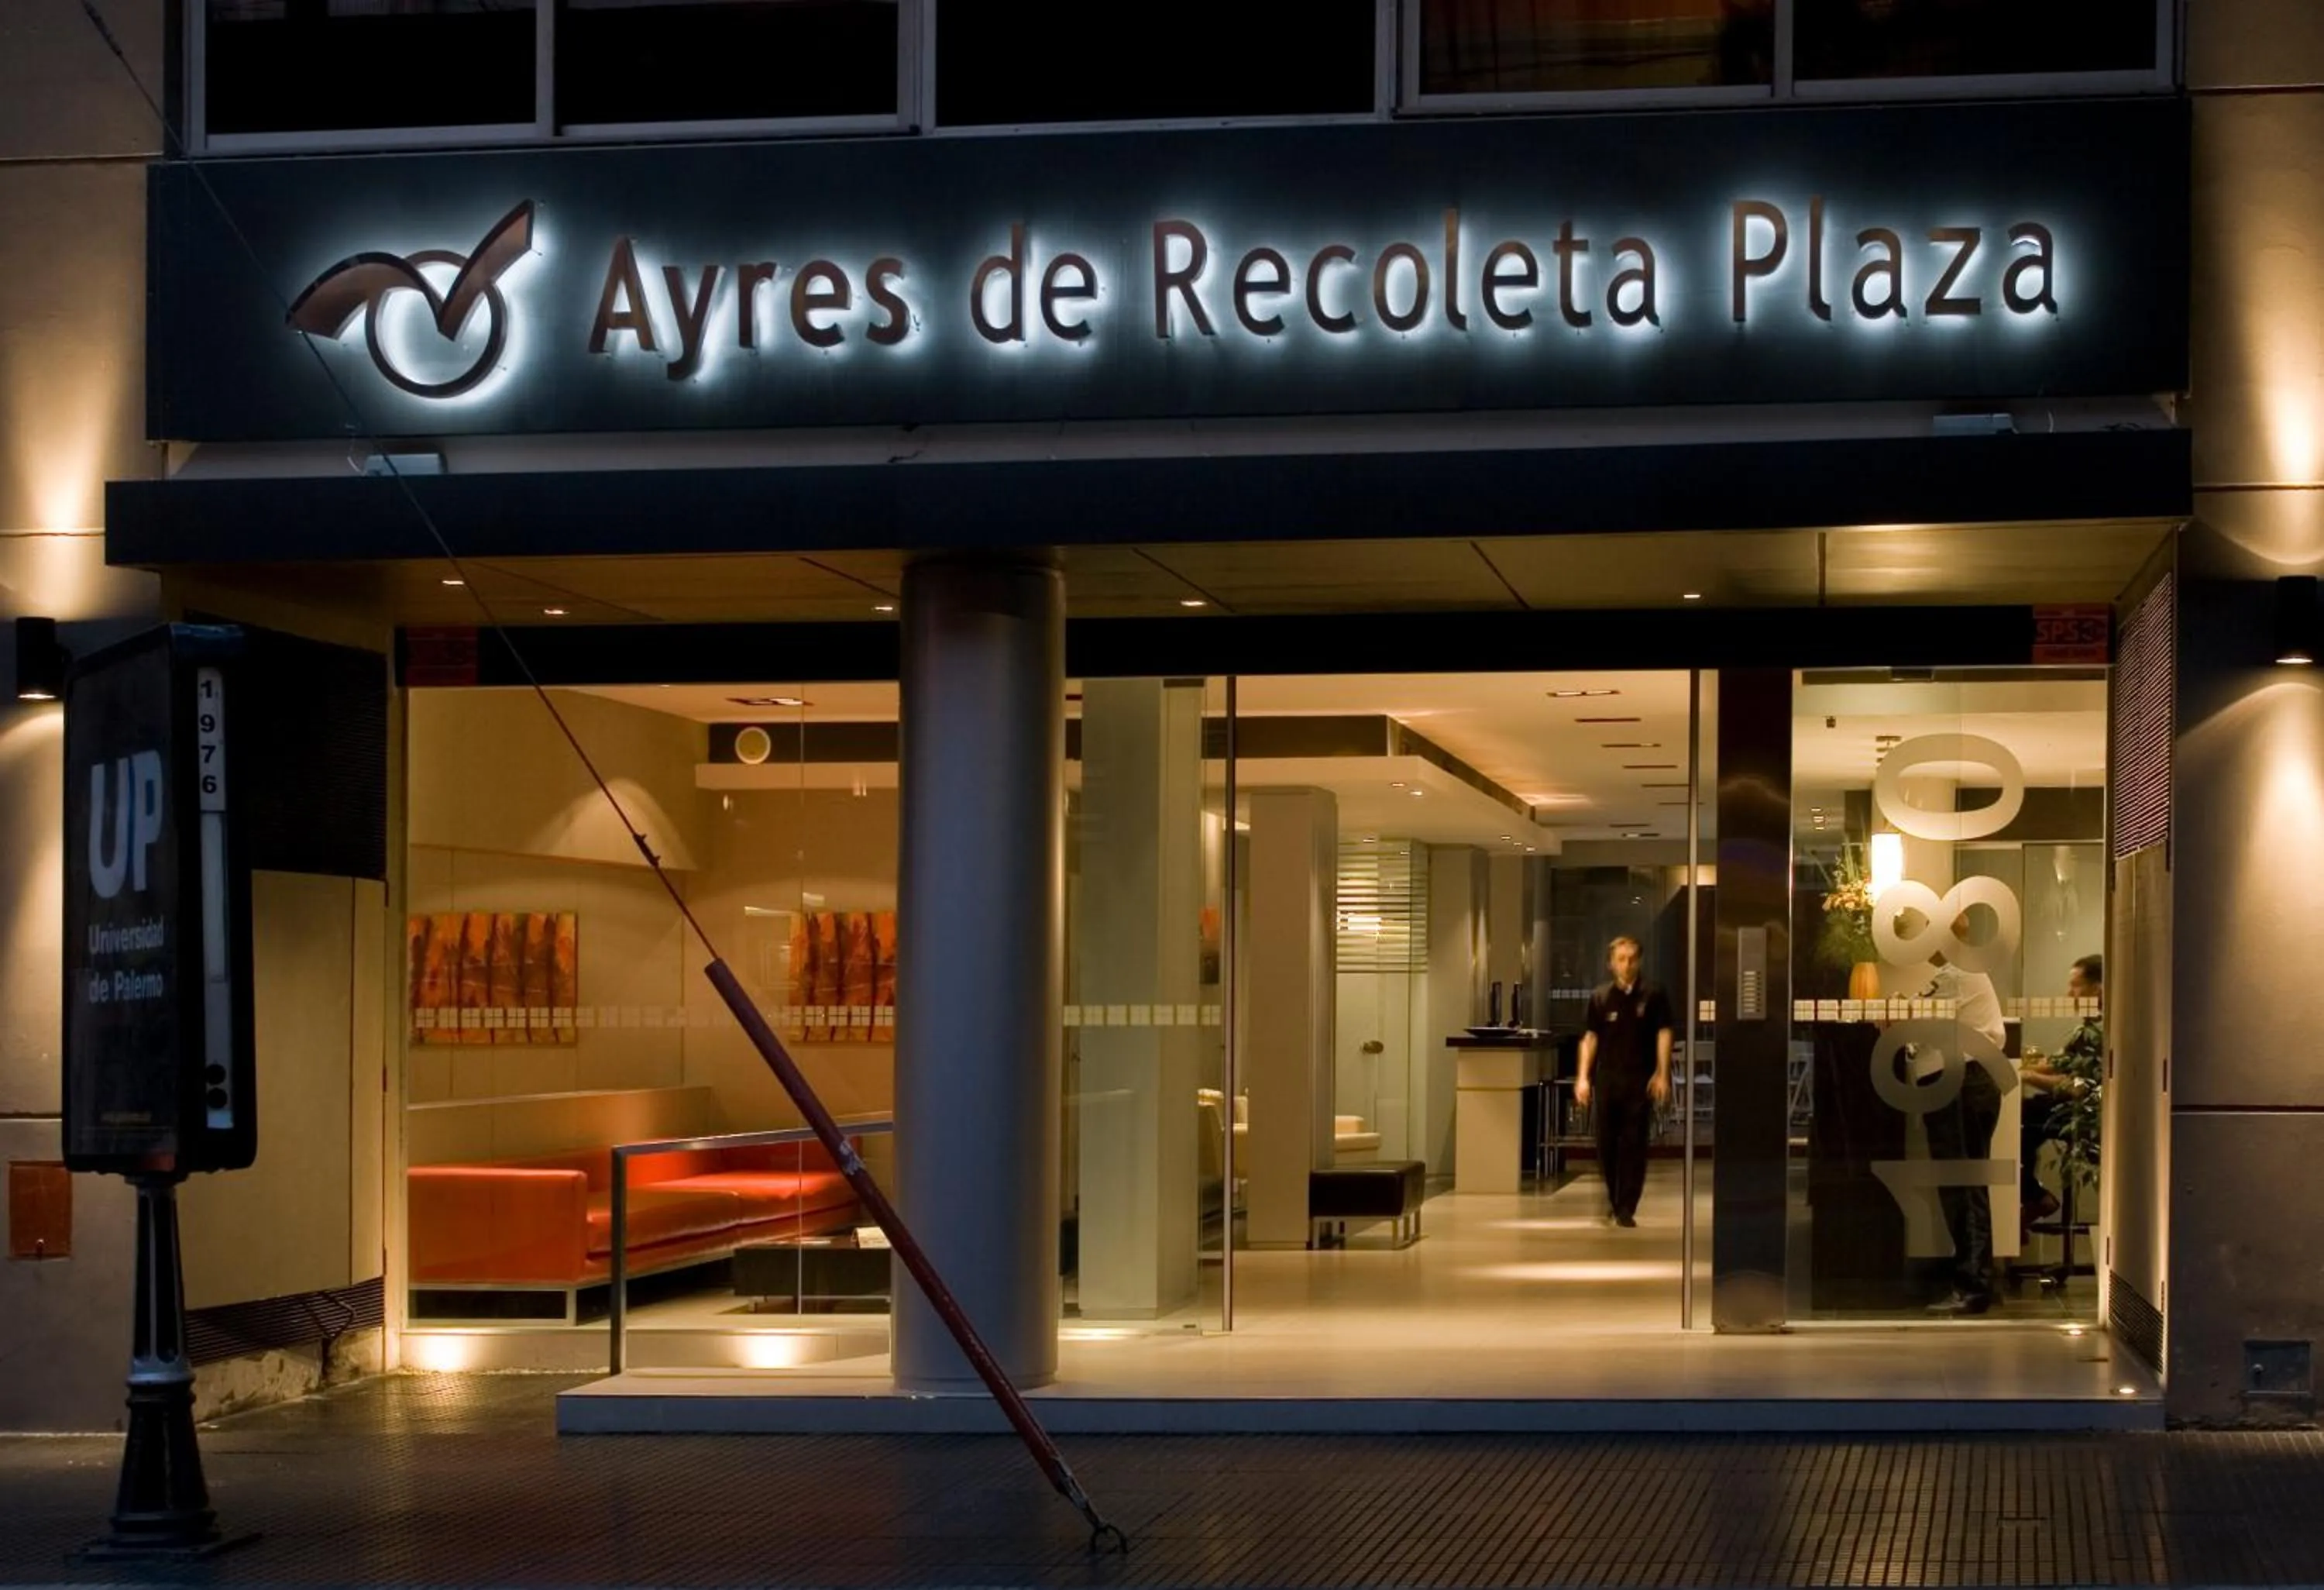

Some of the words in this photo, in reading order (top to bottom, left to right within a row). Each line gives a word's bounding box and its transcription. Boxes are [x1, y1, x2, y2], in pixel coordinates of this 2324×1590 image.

[589, 237, 911, 381] Ayres
[970, 222, 1098, 344] de
[1153, 208, 1660, 339] Recoleta
[1733, 194, 2058, 322] Plaza
[88, 749, 163, 899] UP
[88, 914, 164, 955] Universidad
[89, 972, 109, 1004] de
[115, 969, 163, 1002] Palermo
[1871, 733, 2023, 1218] 1980
